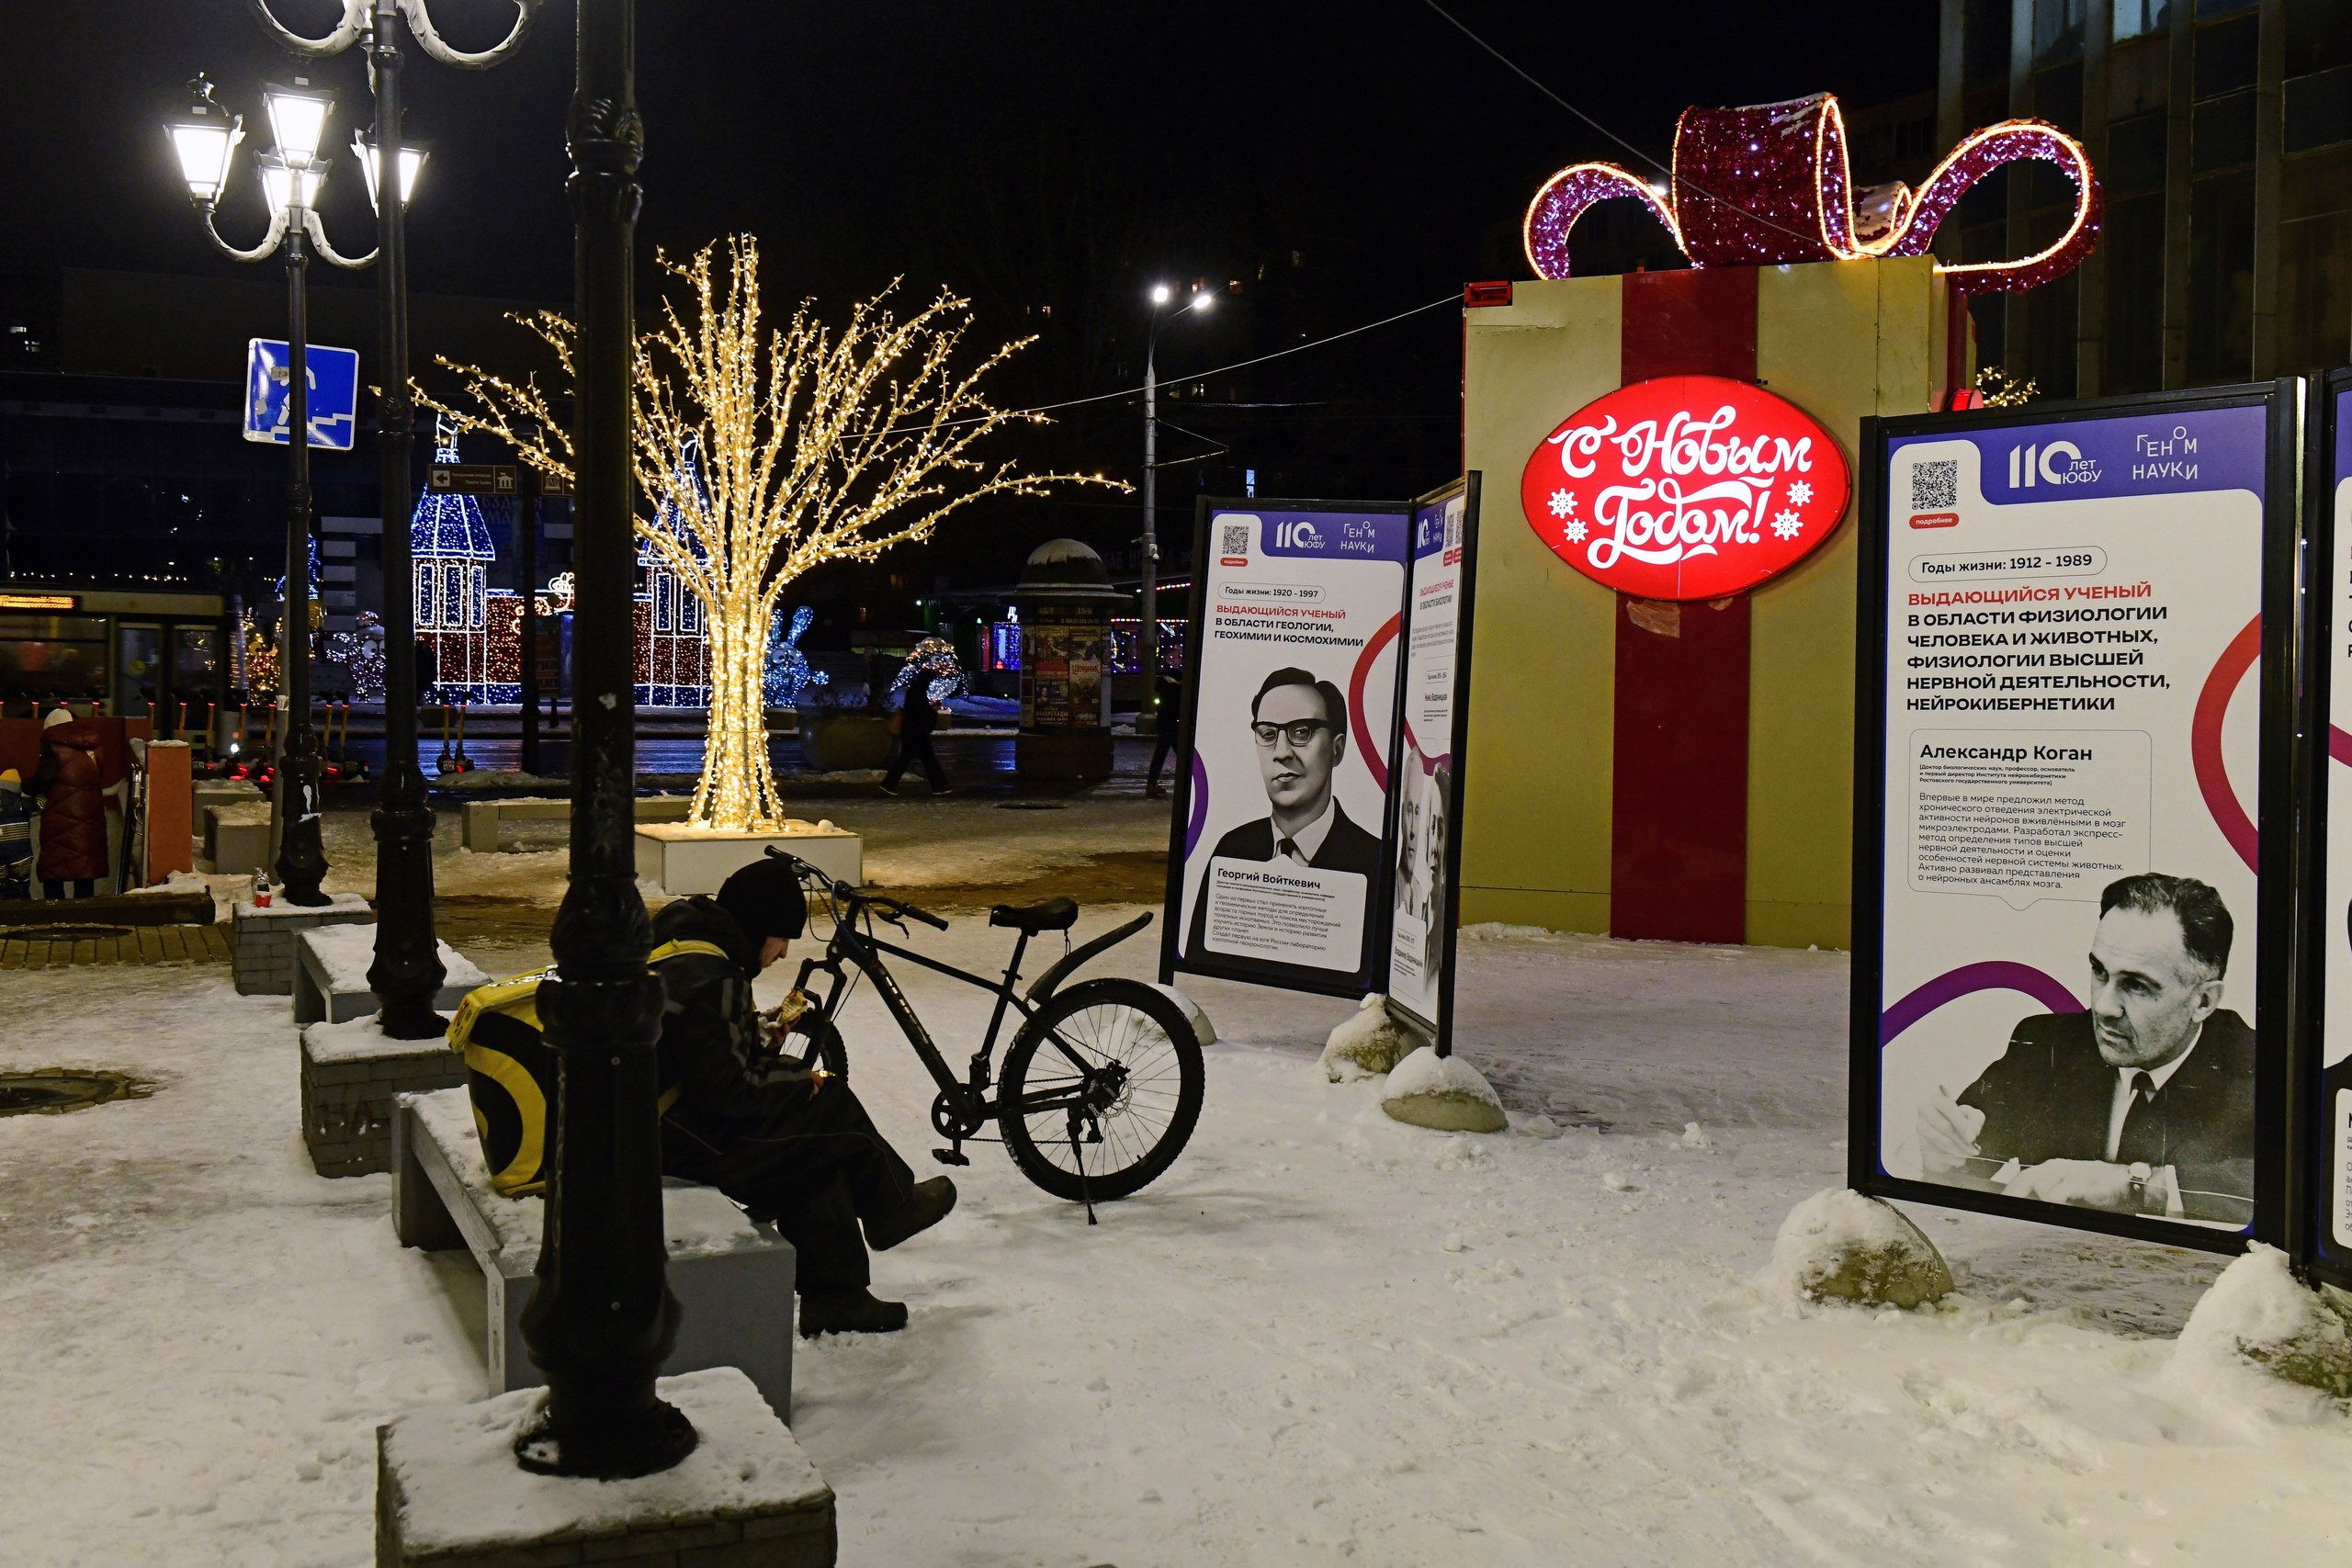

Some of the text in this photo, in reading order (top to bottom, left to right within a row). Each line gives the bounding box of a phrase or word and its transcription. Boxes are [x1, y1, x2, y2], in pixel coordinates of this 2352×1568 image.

[1547, 405, 1812, 478] С Новым
[2136, 424, 2197, 457] ГЕНОМ
[2068, 459, 2096, 471] лет
[2132, 459, 2198, 483] НАУКИ
[2063, 469, 2101, 484] ЮФУ
[1343, 520, 1375, 537] ГЕНОМ
[1588, 477, 1775, 569] Годом!
[1916, 517, 1953, 525] подробнее
[1303, 540, 1325, 548] ЮФУ
[1340, 540, 1374, 553] НАУКИ
[1922, 562, 1955, 574] Годы
[1959, 561, 2007, 571] жизни:
[2010, 557, 2041, 569] 1912
[2056, 555, 2092, 567] 1989
[1225, 586, 1244, 595] Годы
[1272, 589, 1293, 597] 1920
[1299, 590, 1318, 598] 1997
[1908, 581, 2151, 606] ВЫДАЮЩИЙСЯ УЧЕНЫЙ
[1216, 604, 1346, 619] ВЫДАЮЩИЙСЯ УЧЕНЫЙ
[1907, 606, 2166, 626] В ОБЛАСТИ ФИЗИОЛОГИИ
[1216, 617, 1334, 633] В ОБЛАСТИ ГЕОЛОГИИ,
[1215, 630, 1363, 647] ГЕОХИМИИ И КОСМОХИМИИ
[1907, 630, 2157, 647] ЧЕЛОВЕКА И ЖИВОТНЫХ,
[1907, 649, 2143, 669] ФИЗИОЛОГИИ ВЫСШЕЙ
[1907, 673, 2170, 691] НЕРВНОЙ ДЕЯТЕЛЬНОСТИ,
[1907, 695, 2114, 710] НЕЙРОКИБЕРНЕТИКИ
[1920, 744, 2092, 762] Александр Коган
[1919, 792, 1961, 803] Впервые
[1970, 795, 1995, 805] мире
[1996, 796, 2052, 806] предложил
[2054, 798, 2085, 807] метод
[1918, 804, 2111, 818] хронического отведения электрической
[1918, 814, 1971, 822] активности
[1973, 815, 2019, 825] нейронов
[2022, 817, 2092, 827] вживлёнными
[1918, 824, 2123, 839] микроэлектродами. Разработал экспресс-
[1918, 834, 2083, 848] метод определения типов высшей
[1918, 844, 1958, 852] нервной
[1959, 846, 2025, 855] деятельности
[2035, 849, 2071, 857] оценки
[1917, 853, 2124, 871] особенностей нервной системы животных.
[1218, 868, 1320, 889] Георгий Войткевич
[1917, 863, 2080, 879] Активно развивал представления
[1926, 874, 1978, 884] нейронных
[1980, 877, 2030, 887] ансамблях
